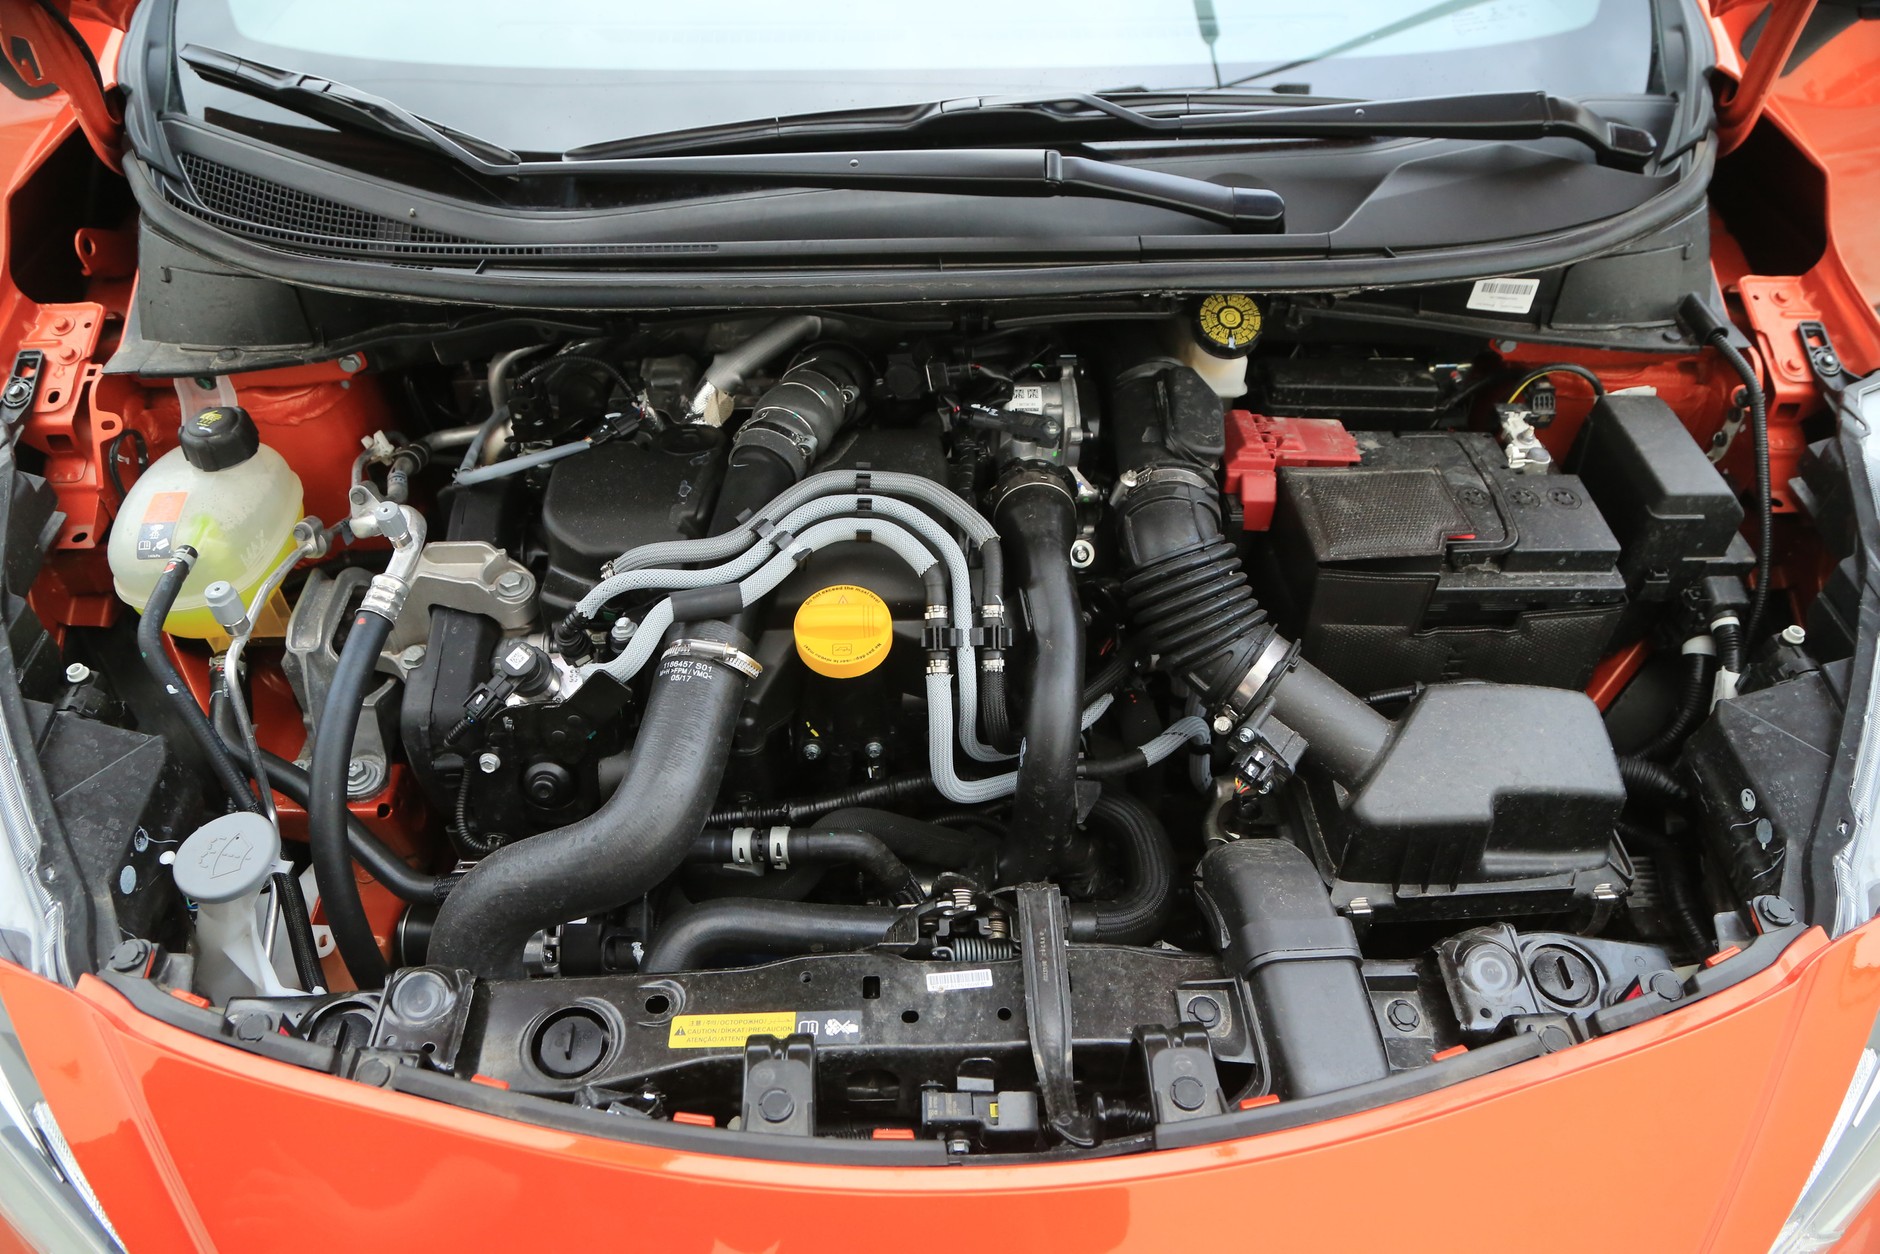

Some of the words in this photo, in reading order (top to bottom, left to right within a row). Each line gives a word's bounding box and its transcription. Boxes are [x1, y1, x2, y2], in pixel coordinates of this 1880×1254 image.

[821, 586, 843, 595] exceed
[695, 663, 713, 673] S01
[670, 674, 692, 682] 05/17
